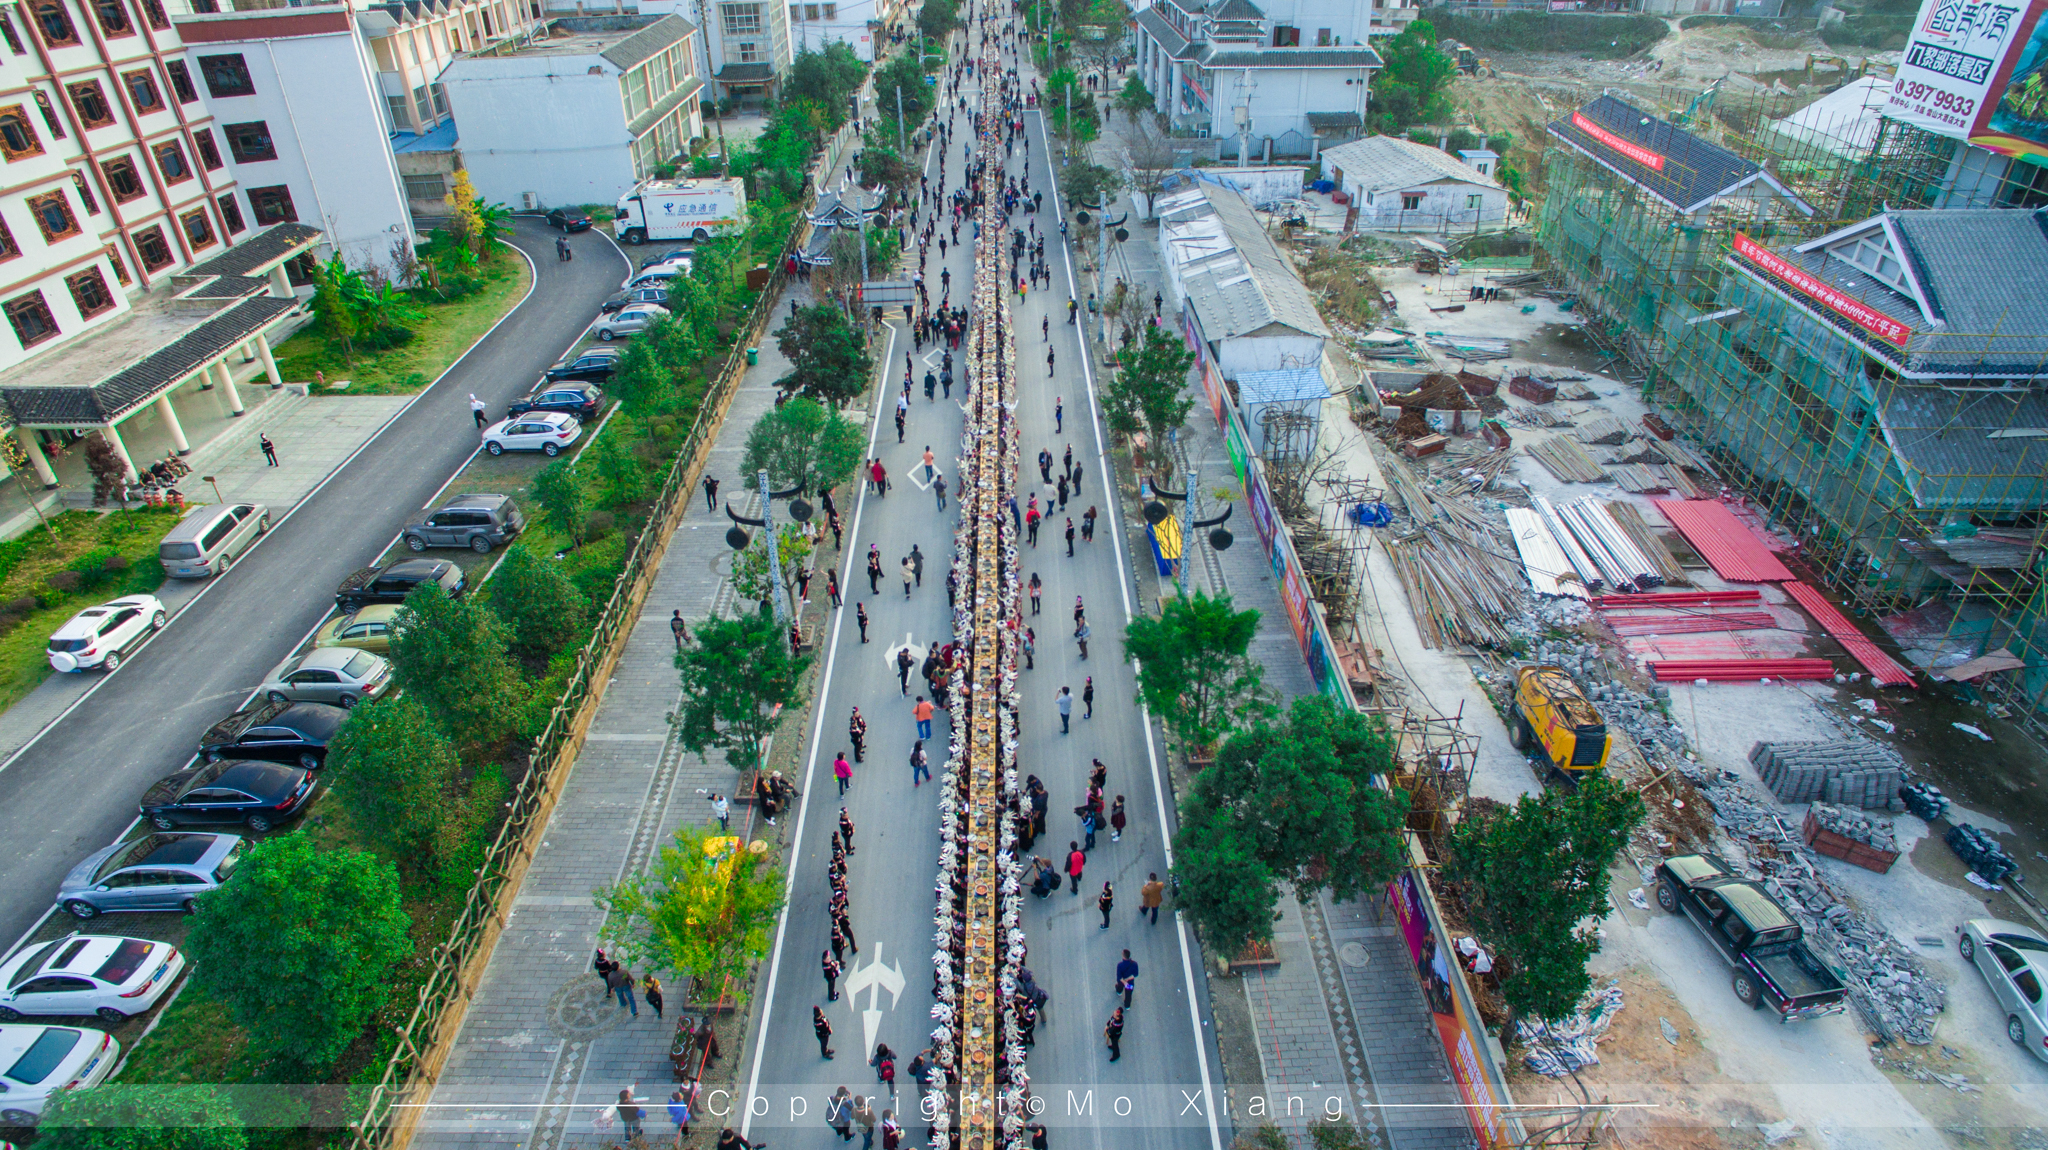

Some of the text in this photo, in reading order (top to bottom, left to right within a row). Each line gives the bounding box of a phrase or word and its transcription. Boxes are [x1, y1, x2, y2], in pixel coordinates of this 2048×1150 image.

[1907, 43, 1991, 82] 九黎部落景区
[1904, 81, 1975, 116] 397 9933
[678, 203, 718, 213] 应急通信
